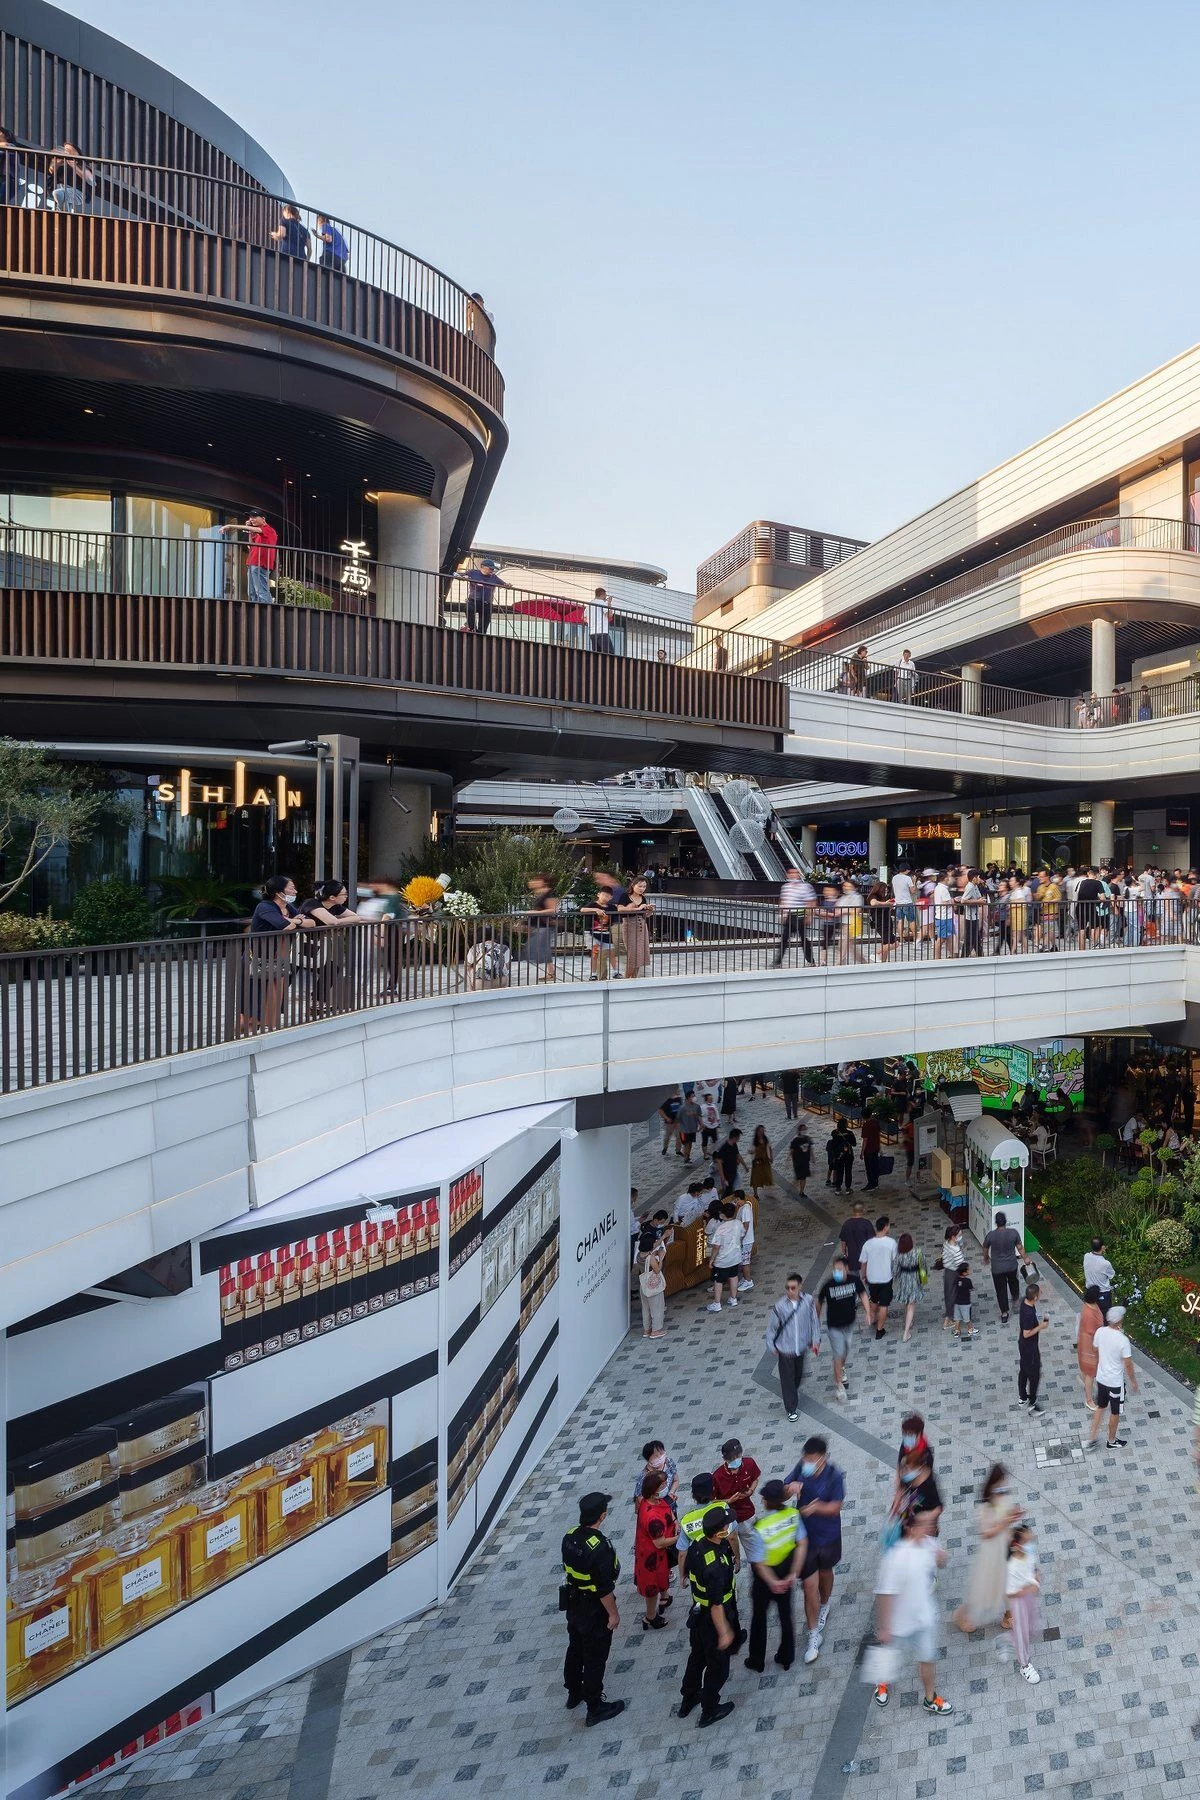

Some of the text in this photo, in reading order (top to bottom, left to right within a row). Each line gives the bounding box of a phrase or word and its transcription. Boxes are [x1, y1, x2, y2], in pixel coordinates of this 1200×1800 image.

[815, 841, 868, 856] OUCOU
[577, 1209, 617, 1262] CHANEL
[349, 1453, 372, 1468] CHANEL
[56, 1477, 100, 1498] CHANEL
[153, 1483, 189, 1502] CHANEL
[284, 1486, 311, 1503] CHANEL
[61, 1525, 102, 1548] CHANEL
[209, 1526, 238, 1544] CHANEL
[125, 1569, 159, 1590] CHANEL
[28, 1618, 66, 1641] CHANEL
